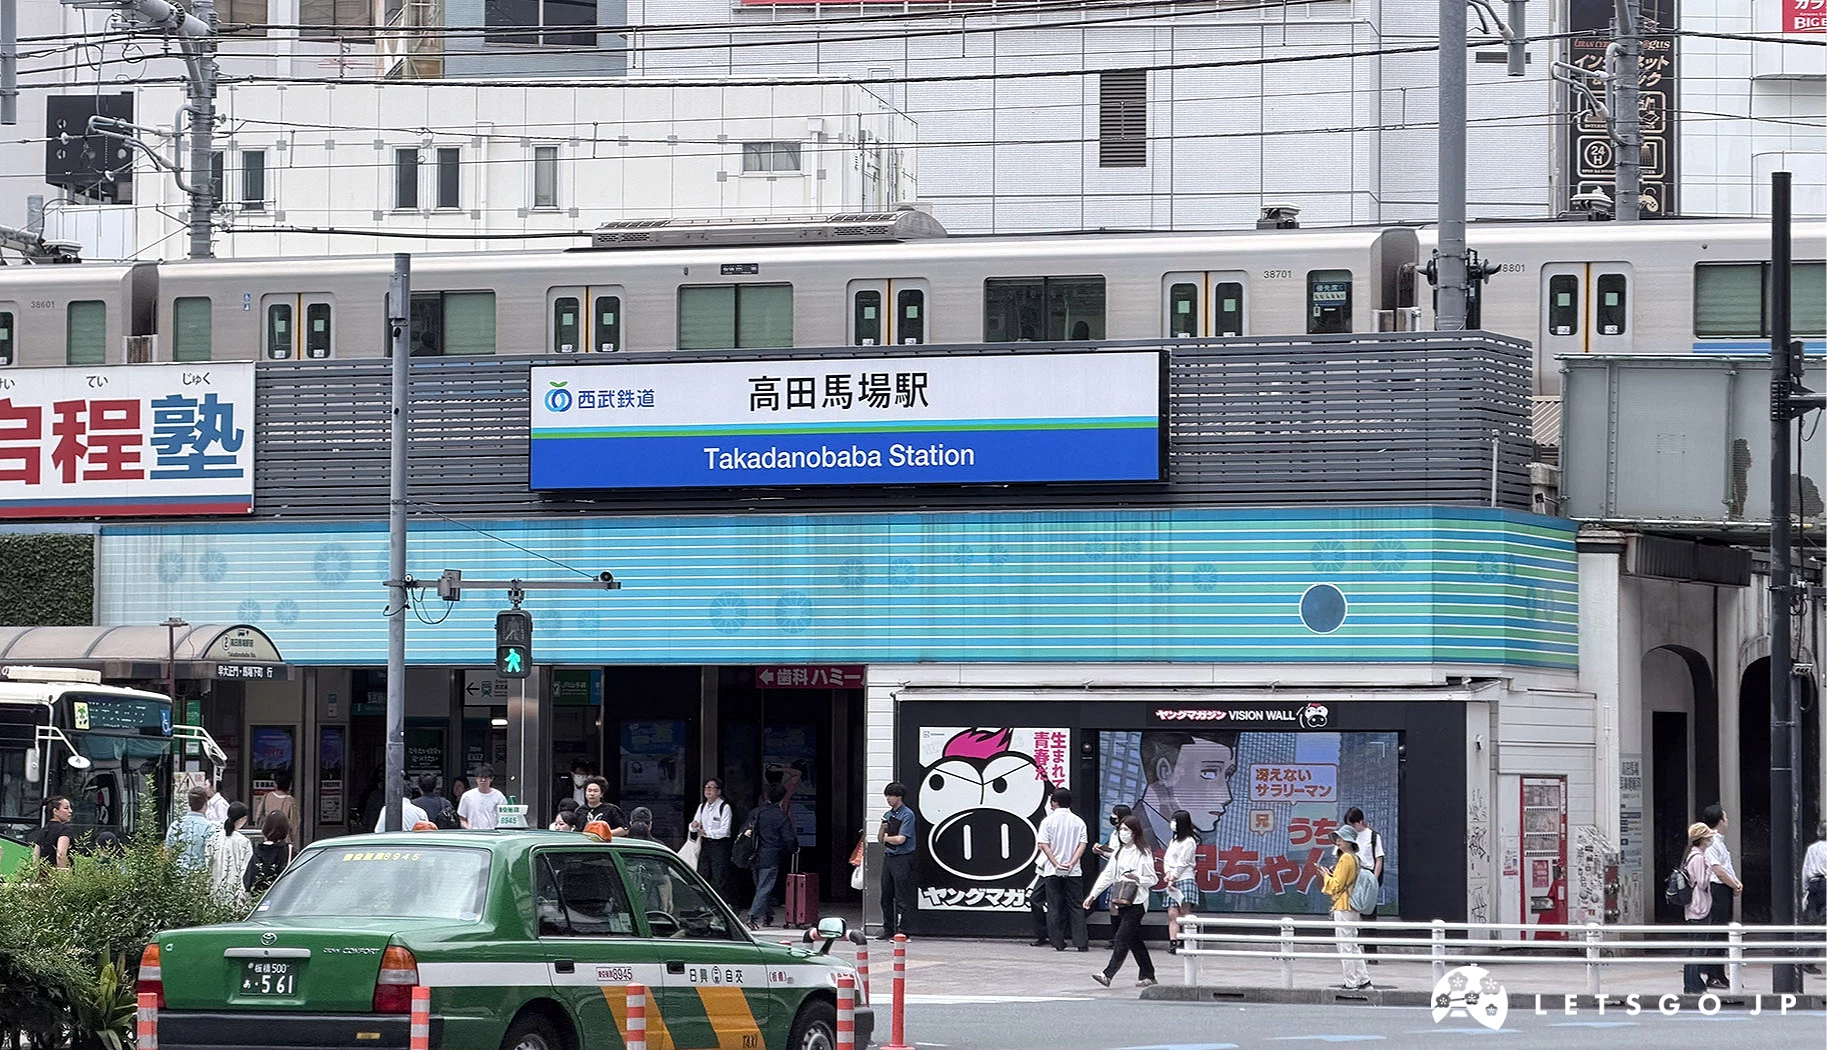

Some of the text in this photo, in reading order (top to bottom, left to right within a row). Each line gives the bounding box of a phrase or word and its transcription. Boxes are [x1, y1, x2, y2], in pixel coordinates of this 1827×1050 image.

[1591, 145, 1606, 156] 24
[1263, 270, 1292, 278] 38701
[86, 375, 109, 388] てい
[182, 372, 211, 385] じゅく
[578, 389, 655, 409] 西武鉄道
[748, 372, 929, 412] 高田馬場駅
[704, 444, 975, 470] Takadanobaba Station
[777, 667, 866, 686] 歯科ハミー
[1155, 709, 1297, 721] ヤングマガジン VISION WALL
[1255, 768, 1312, 782] 冴えない
[1255, 783, 1332, 798] サラリーマン
[1256, 813, 1270, 829] 兄
